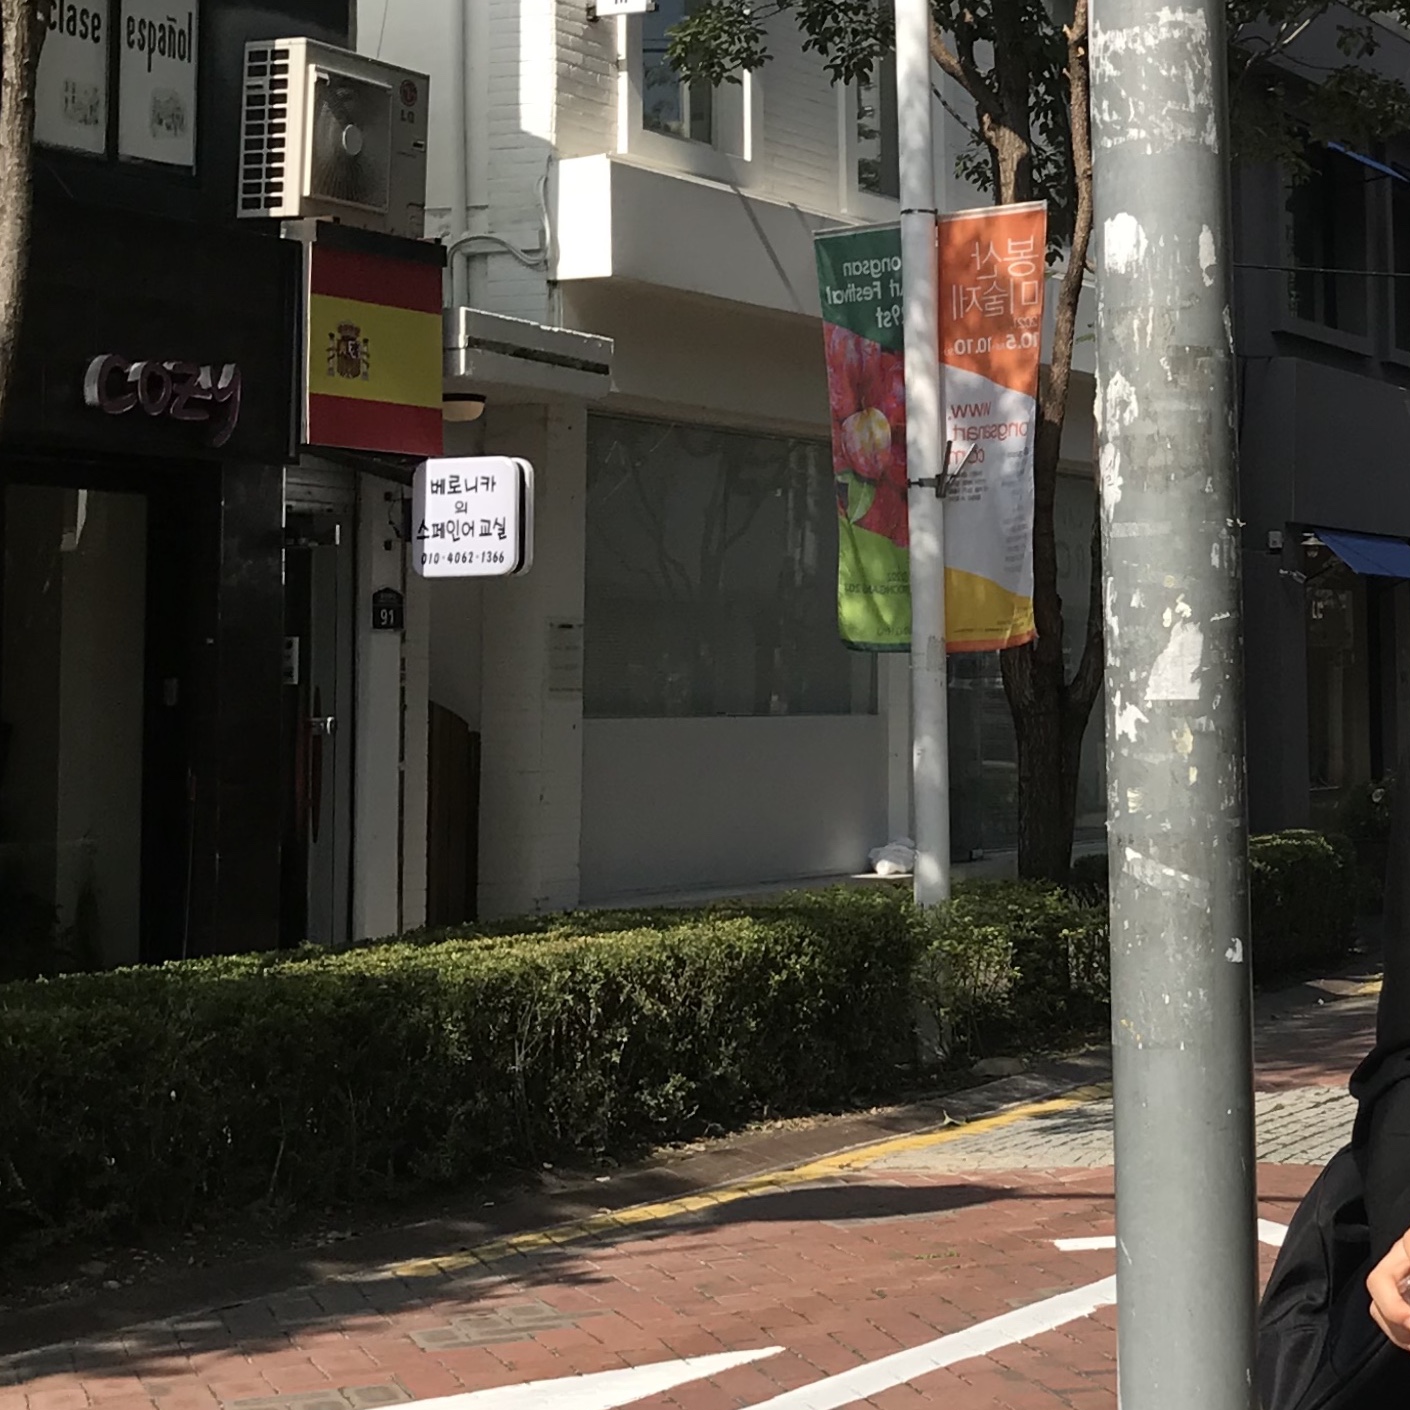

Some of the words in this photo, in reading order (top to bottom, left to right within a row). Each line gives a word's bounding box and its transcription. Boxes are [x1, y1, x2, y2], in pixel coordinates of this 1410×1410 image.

[48, 0, 101, 43] clase
[127, 12, 192, 73] español
[430, 474, 497, 495] 베로니카
[416, 518, 475, 542] 스페인어
[479, 516, 507, 540] 교실
[380, 609, 395, 626] 91
